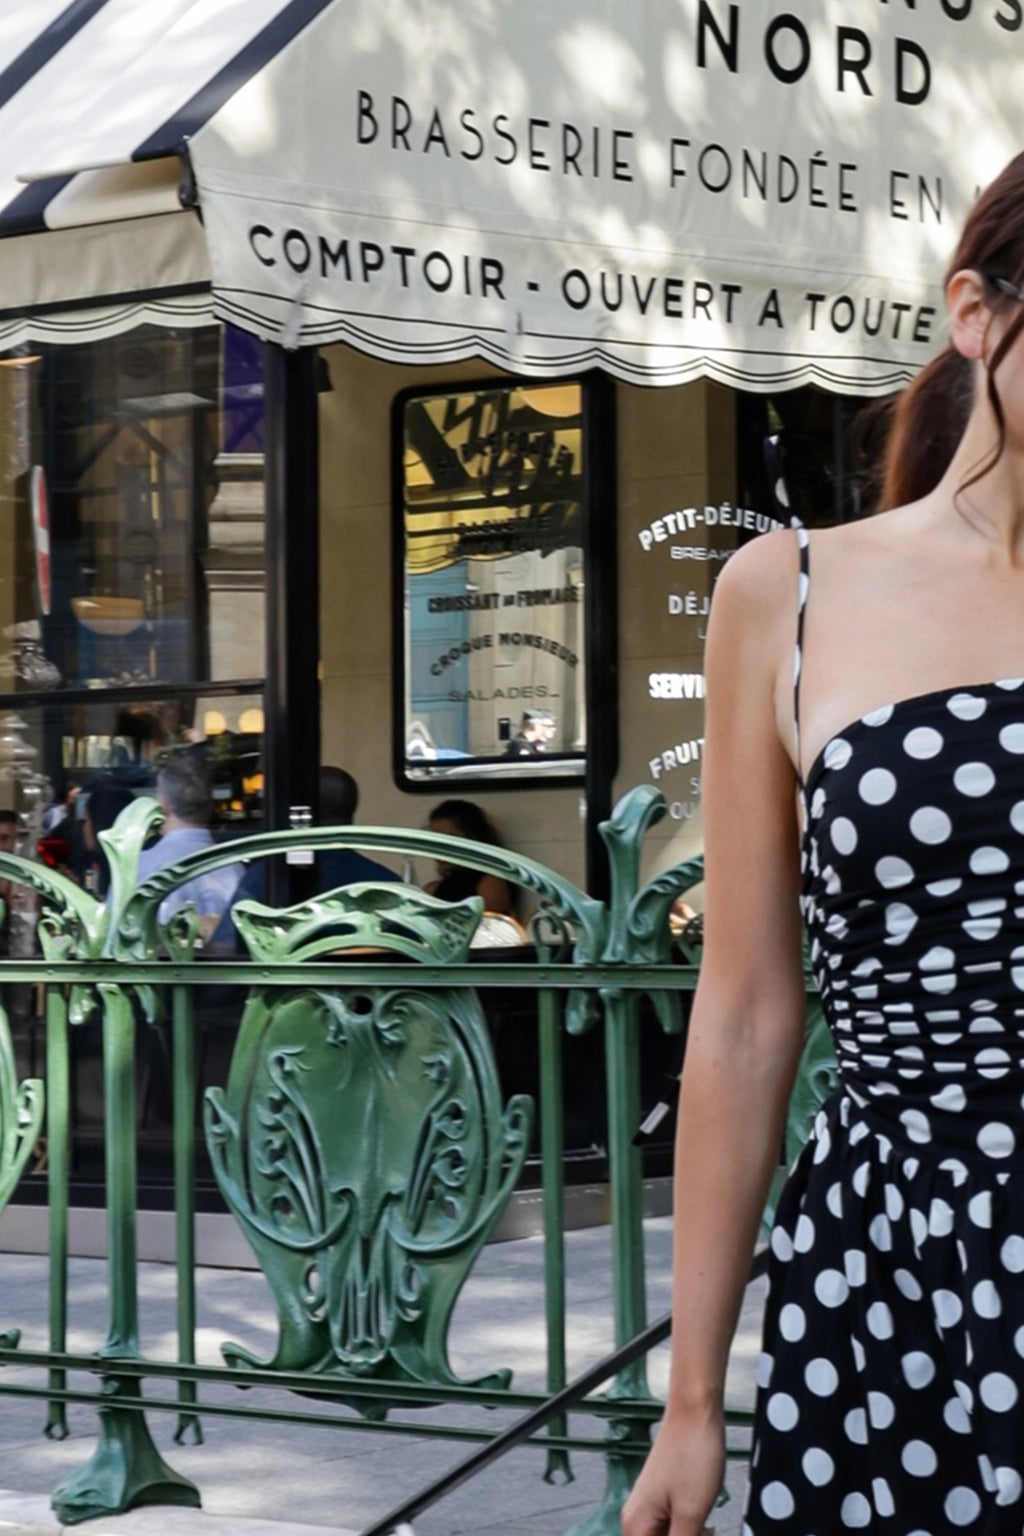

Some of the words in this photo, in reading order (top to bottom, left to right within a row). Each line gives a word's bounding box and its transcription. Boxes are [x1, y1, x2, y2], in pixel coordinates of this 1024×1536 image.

[696, 2, 931, 105] NORD
[357, 89, 634, 182] BRASSERIE
[670, 138, 858, 212] FONDÉE
[890, 170, 942, 224] EN
[250, 225, 506, 300] COMPTOIR
[562, 268, 742, 323] OUVERT
[757, 289, 784, 329] A
[805, 293, 937, 343] TOUTE
[430, 635, 493, 677] CROQUE
[498, 632, 579, 669] MONSIEUR
[648, 672, 706, 699] SERVI
